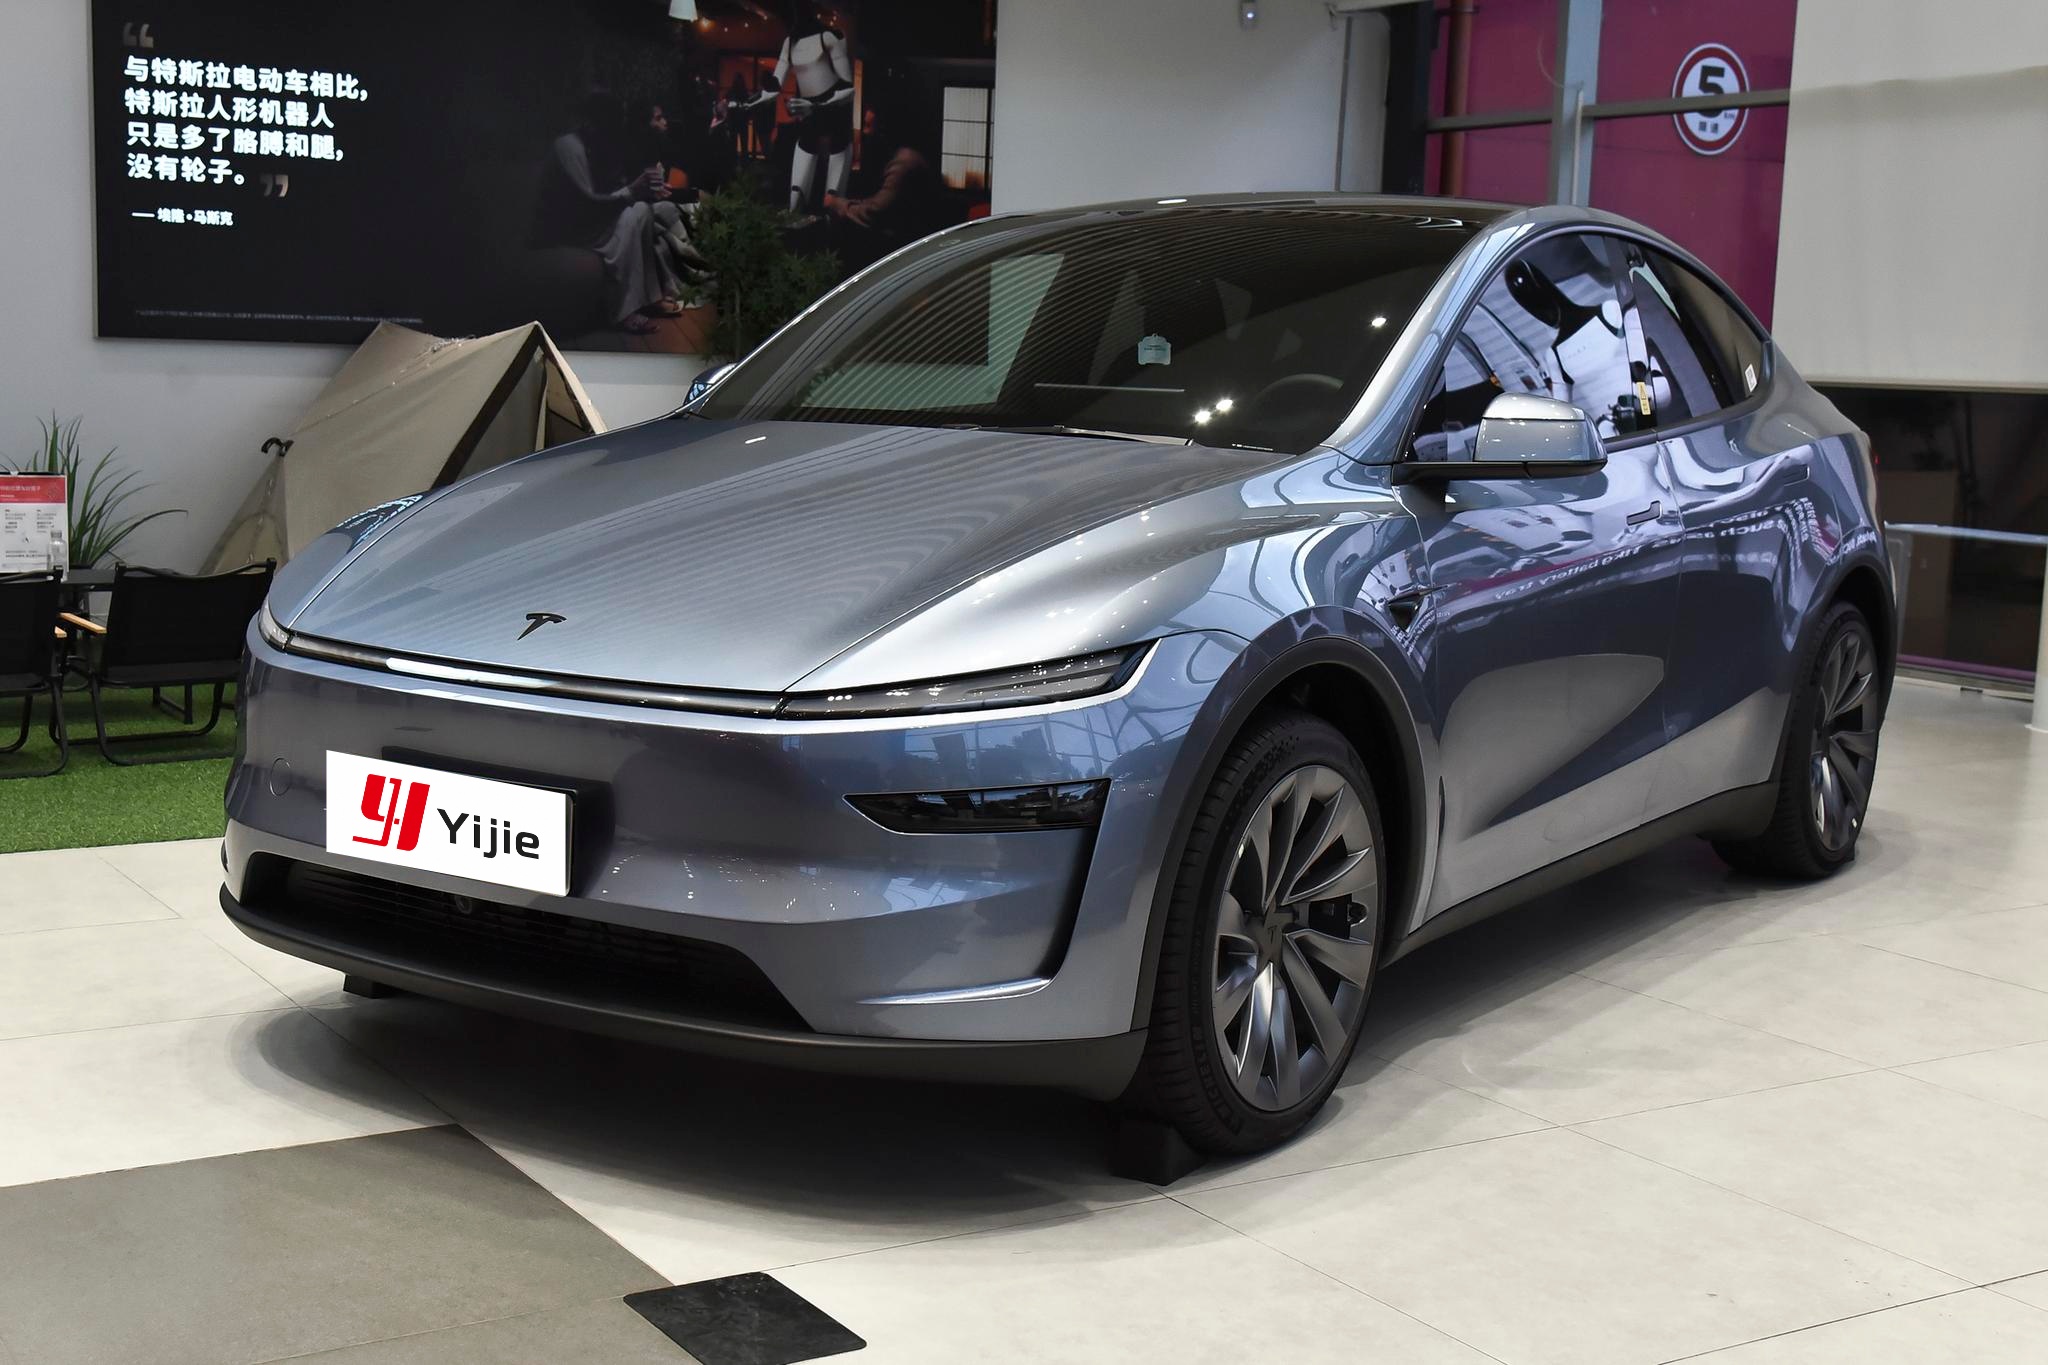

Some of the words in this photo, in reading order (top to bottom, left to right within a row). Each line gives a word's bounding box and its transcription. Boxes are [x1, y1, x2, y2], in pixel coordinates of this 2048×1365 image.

[123, 55, 369, 102] 与特斯拉电动车相比，
[1698, 65, 1725, 118] 5
[123, 87, 335, 129] 特斯拉人形机器人
[126, 121, 345, 162] 只是多了胳膊和腿，
[126, 152, 246, 186] 没有轮子。
